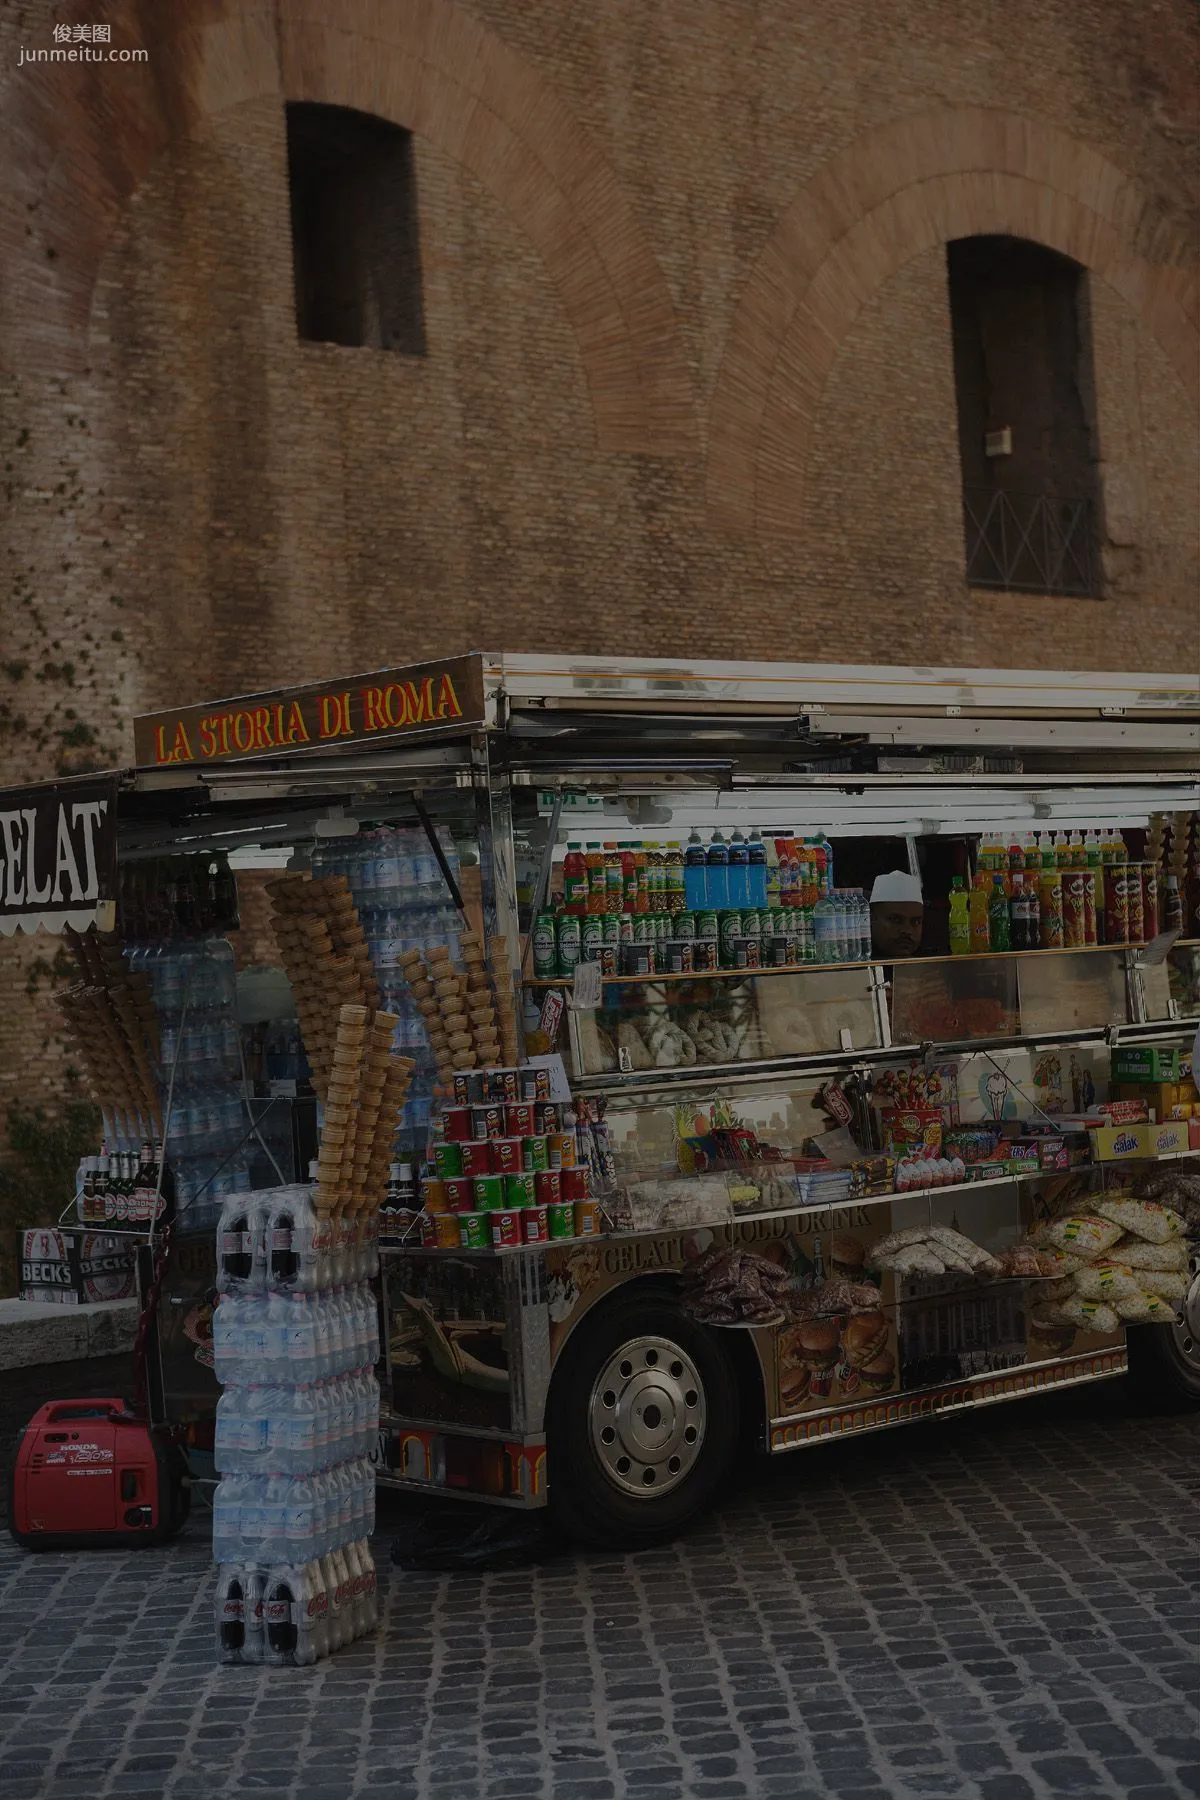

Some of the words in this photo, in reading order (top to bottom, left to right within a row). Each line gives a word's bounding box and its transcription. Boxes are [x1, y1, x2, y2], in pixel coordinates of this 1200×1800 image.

[154, 721, 194, 764] LA
[200, 700, 311, 758] STORIA
[319, 692, 355, 740] DI
[363, 673, 463, 731] ROMA
[0, 800, 108, 906] ELAT
[1113, 1136, 1139, 1154] Galak
[724, 1216, 787, 1245] COLD
[795, 1205, 873, 1236] DRINK
